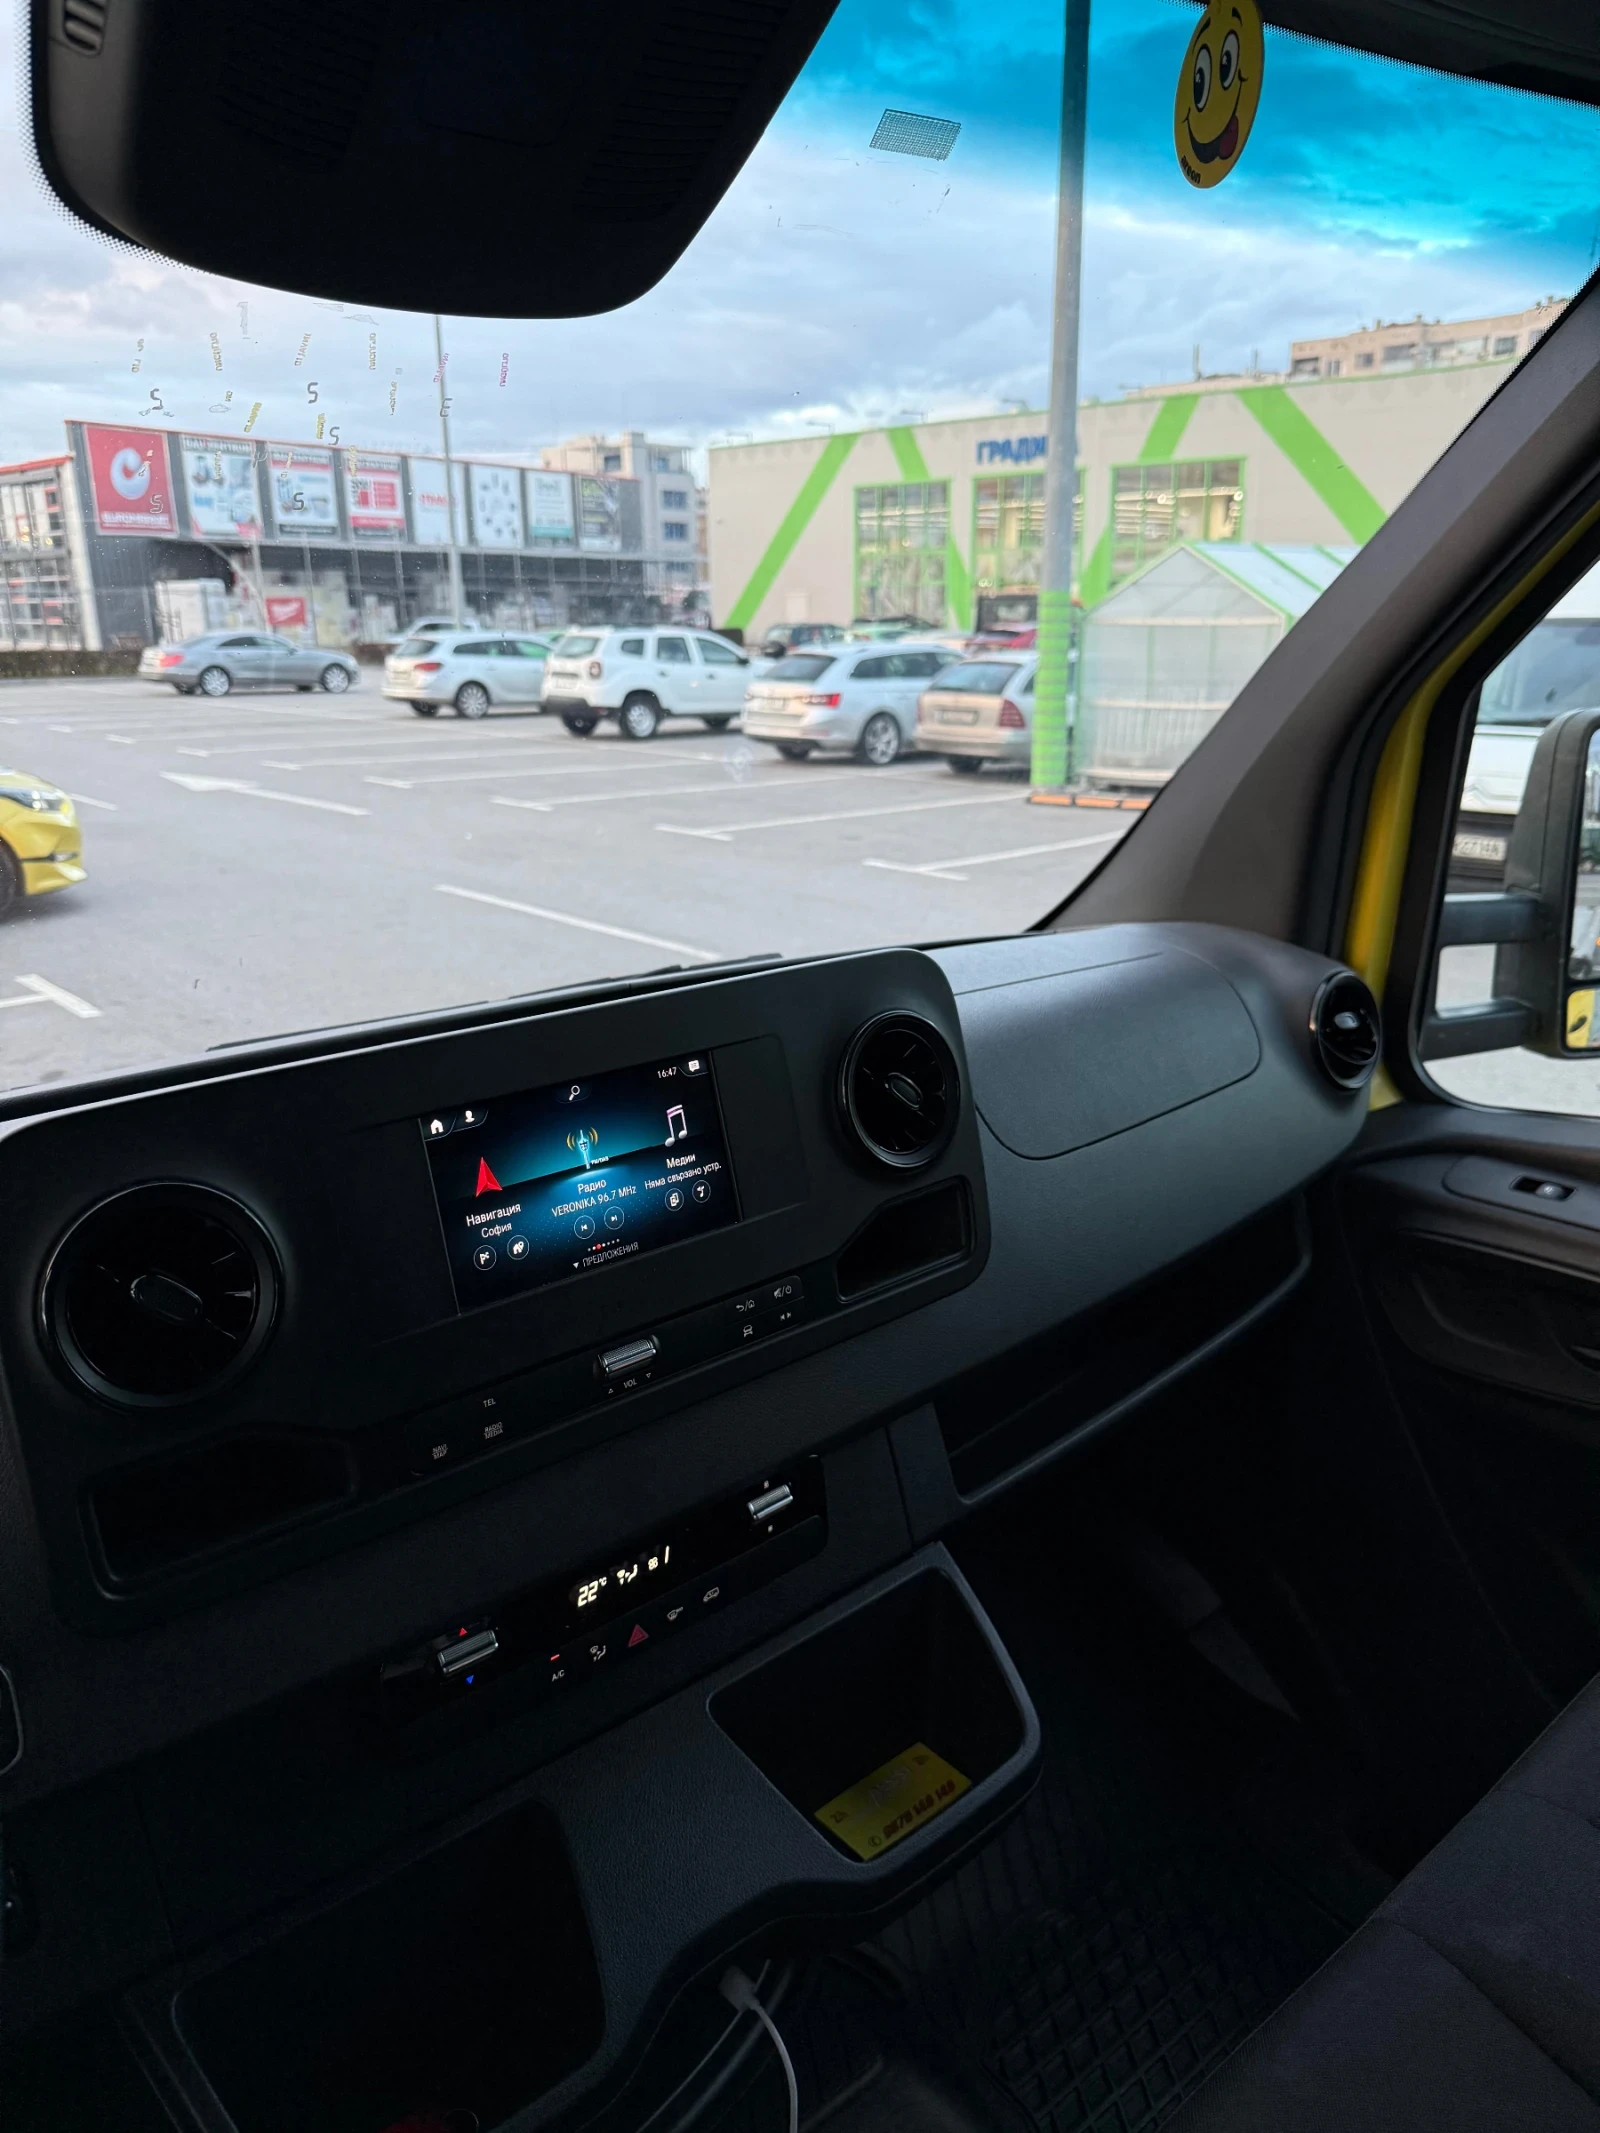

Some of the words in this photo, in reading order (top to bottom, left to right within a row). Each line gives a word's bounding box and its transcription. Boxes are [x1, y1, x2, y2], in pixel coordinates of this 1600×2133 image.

[1181, 155, 1202, 184] areon
[656, 1066, 678, 1079] 16:47
[666, 1152, 696, 1170] Медии
[644, 1177, 666, 1190] Няма
[666, 1168, 702, 1187] свързано
[703, 1162, 722, 1179] устр.
[577, 1178, 607, 1195] Радио
[551, 1197, 597, 1218] VERONIKA
[597, 1190, 617, 1206] 96.7
[618, 1184, 637, 1199] MHz
[465, 1202, 521, 1228] Навигация
[481, 1220, 513, 1240] София
[582, 1240, 640, 1268] ПРЕДЛОЖЕНИЯ
[623, 1376, 638, 1390] VOL
[482, 1397, 497, 1408] TEL
[484, 1421, 503, 1433] RADIO
[551, 1669, 565, 1682] A/C
